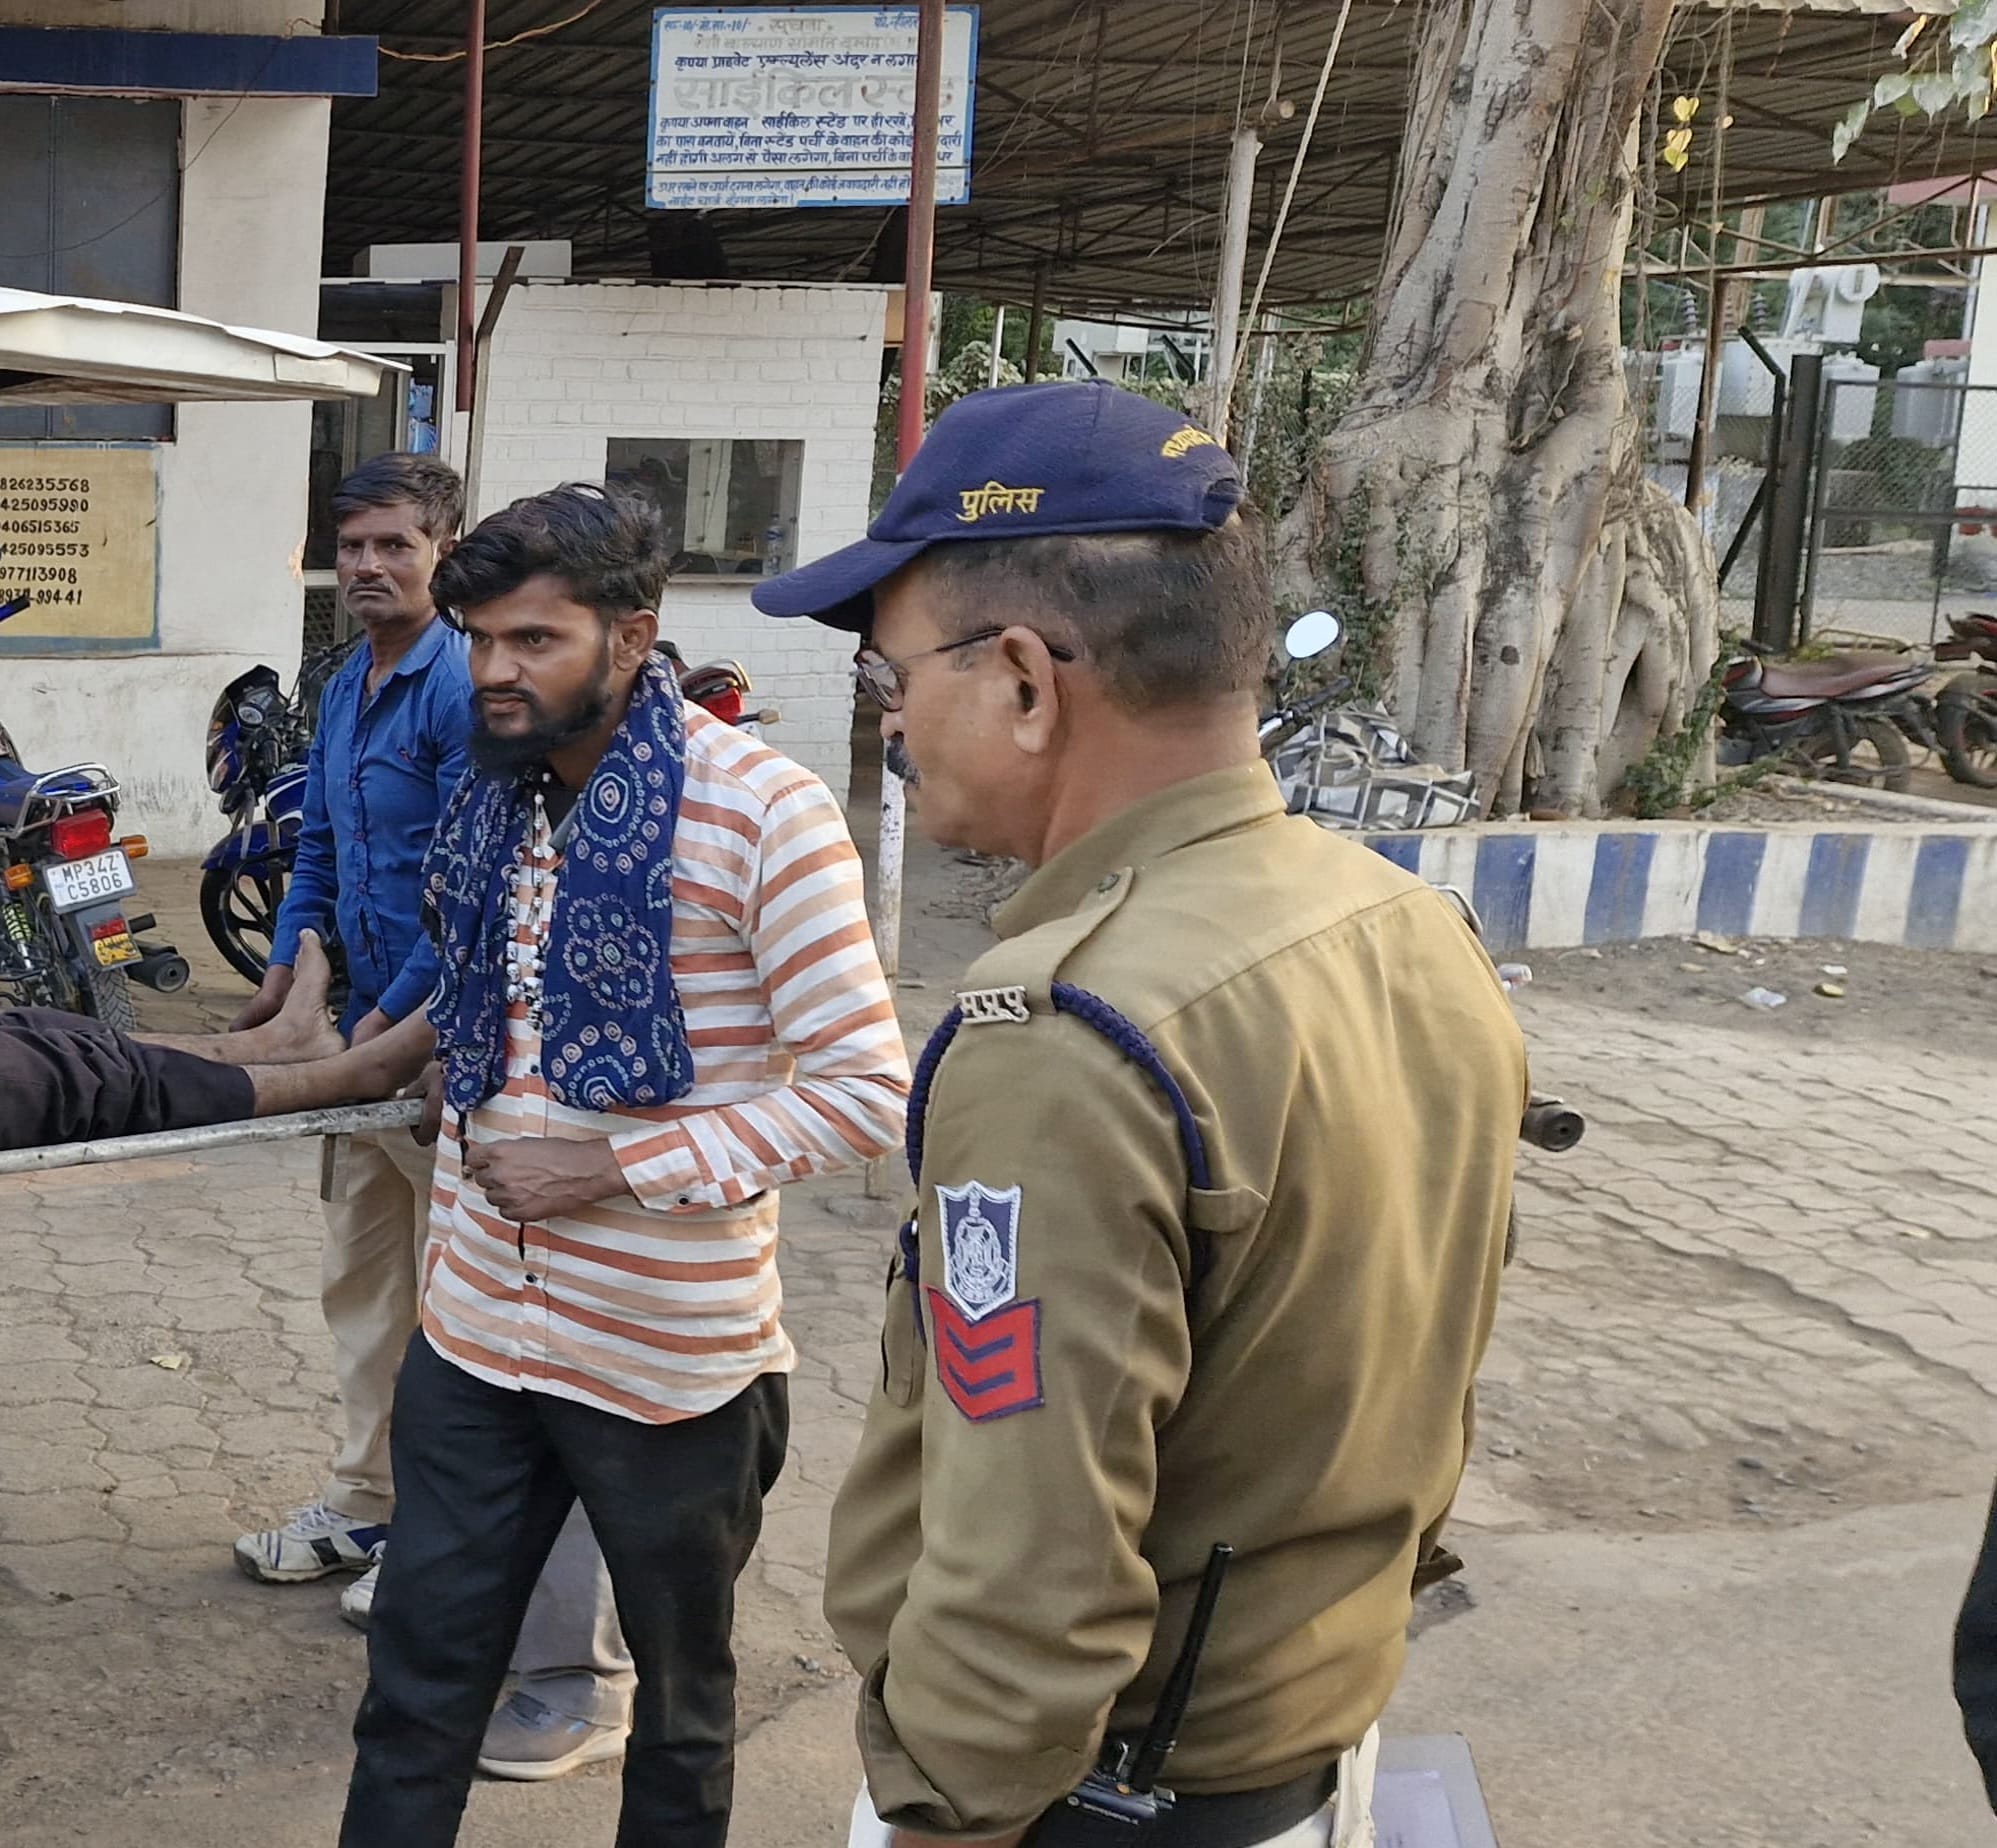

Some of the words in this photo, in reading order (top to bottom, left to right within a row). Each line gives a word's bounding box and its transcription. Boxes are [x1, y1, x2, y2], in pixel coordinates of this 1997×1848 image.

[832, 52, 867, 70] अंदर
[886, 54, 919, 68] लगा
[853, 115, 871, 127] पर
[656, 136, 671, 147] का
[871, 130, 888, 146] की
[956, 480, 1046, 521] पुलिस
[0, 519, 81, 534] 406515365
[62, 855, 119, 882] MP34Z
[67, 873, 123, 901] C5806
